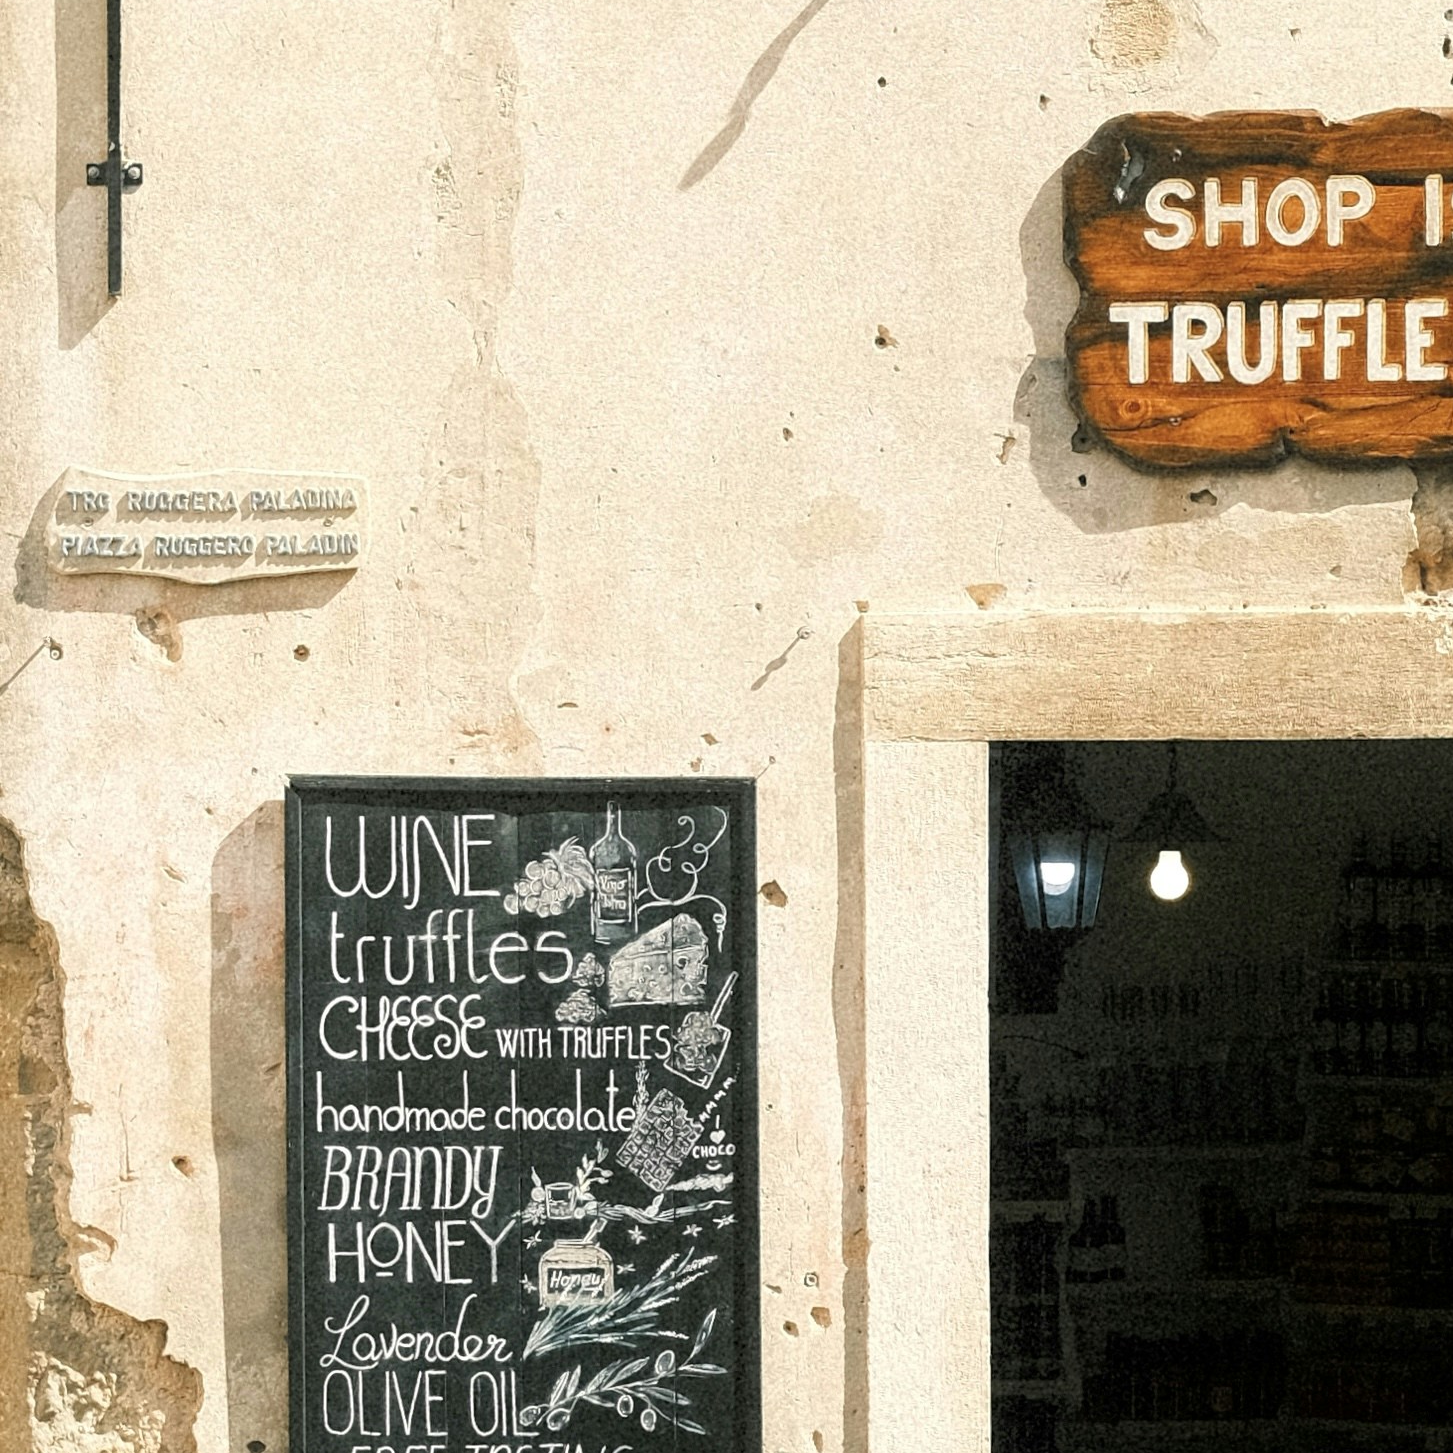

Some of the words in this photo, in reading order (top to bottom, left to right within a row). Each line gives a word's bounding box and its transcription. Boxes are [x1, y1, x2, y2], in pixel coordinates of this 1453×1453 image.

[1144, 174, 1376, 251] SHOP
[1109, 298, 1449, 385] TRUFFLE
[66, 490, 112, 512] TRG
[127, 489, 239, 512] RUGGERA
[250, 487, 358, 511] PALADINA
[62, 534, 144, 558] PIAZZA
[154, 533, 256, 557] RUGGERO
[265, 532, 359, 556] PALADIN
[325, 813, 501, 909] WINE
[331, 909, 574, 985] truffles
[319, 994, 488, 1061] CHEESE
[496, 1028, 552, 1059] WITH
[557, 1025, 672, 1059] TRUFFLES
[315, 1070, 486, 1133] handmade
[495, 1068, 637, 1132] chocolate
[317, 1145, 504, 1219] BRANDY
[692, 1143, 736, 1159] CHOCO
[327, 1220, 517, 1284] HONEY
[319, 1294, 513, 1370] Lavender
[322, 1370, 449, 1437] OLIVE
[469, 1368, 540, 1438] OIL
